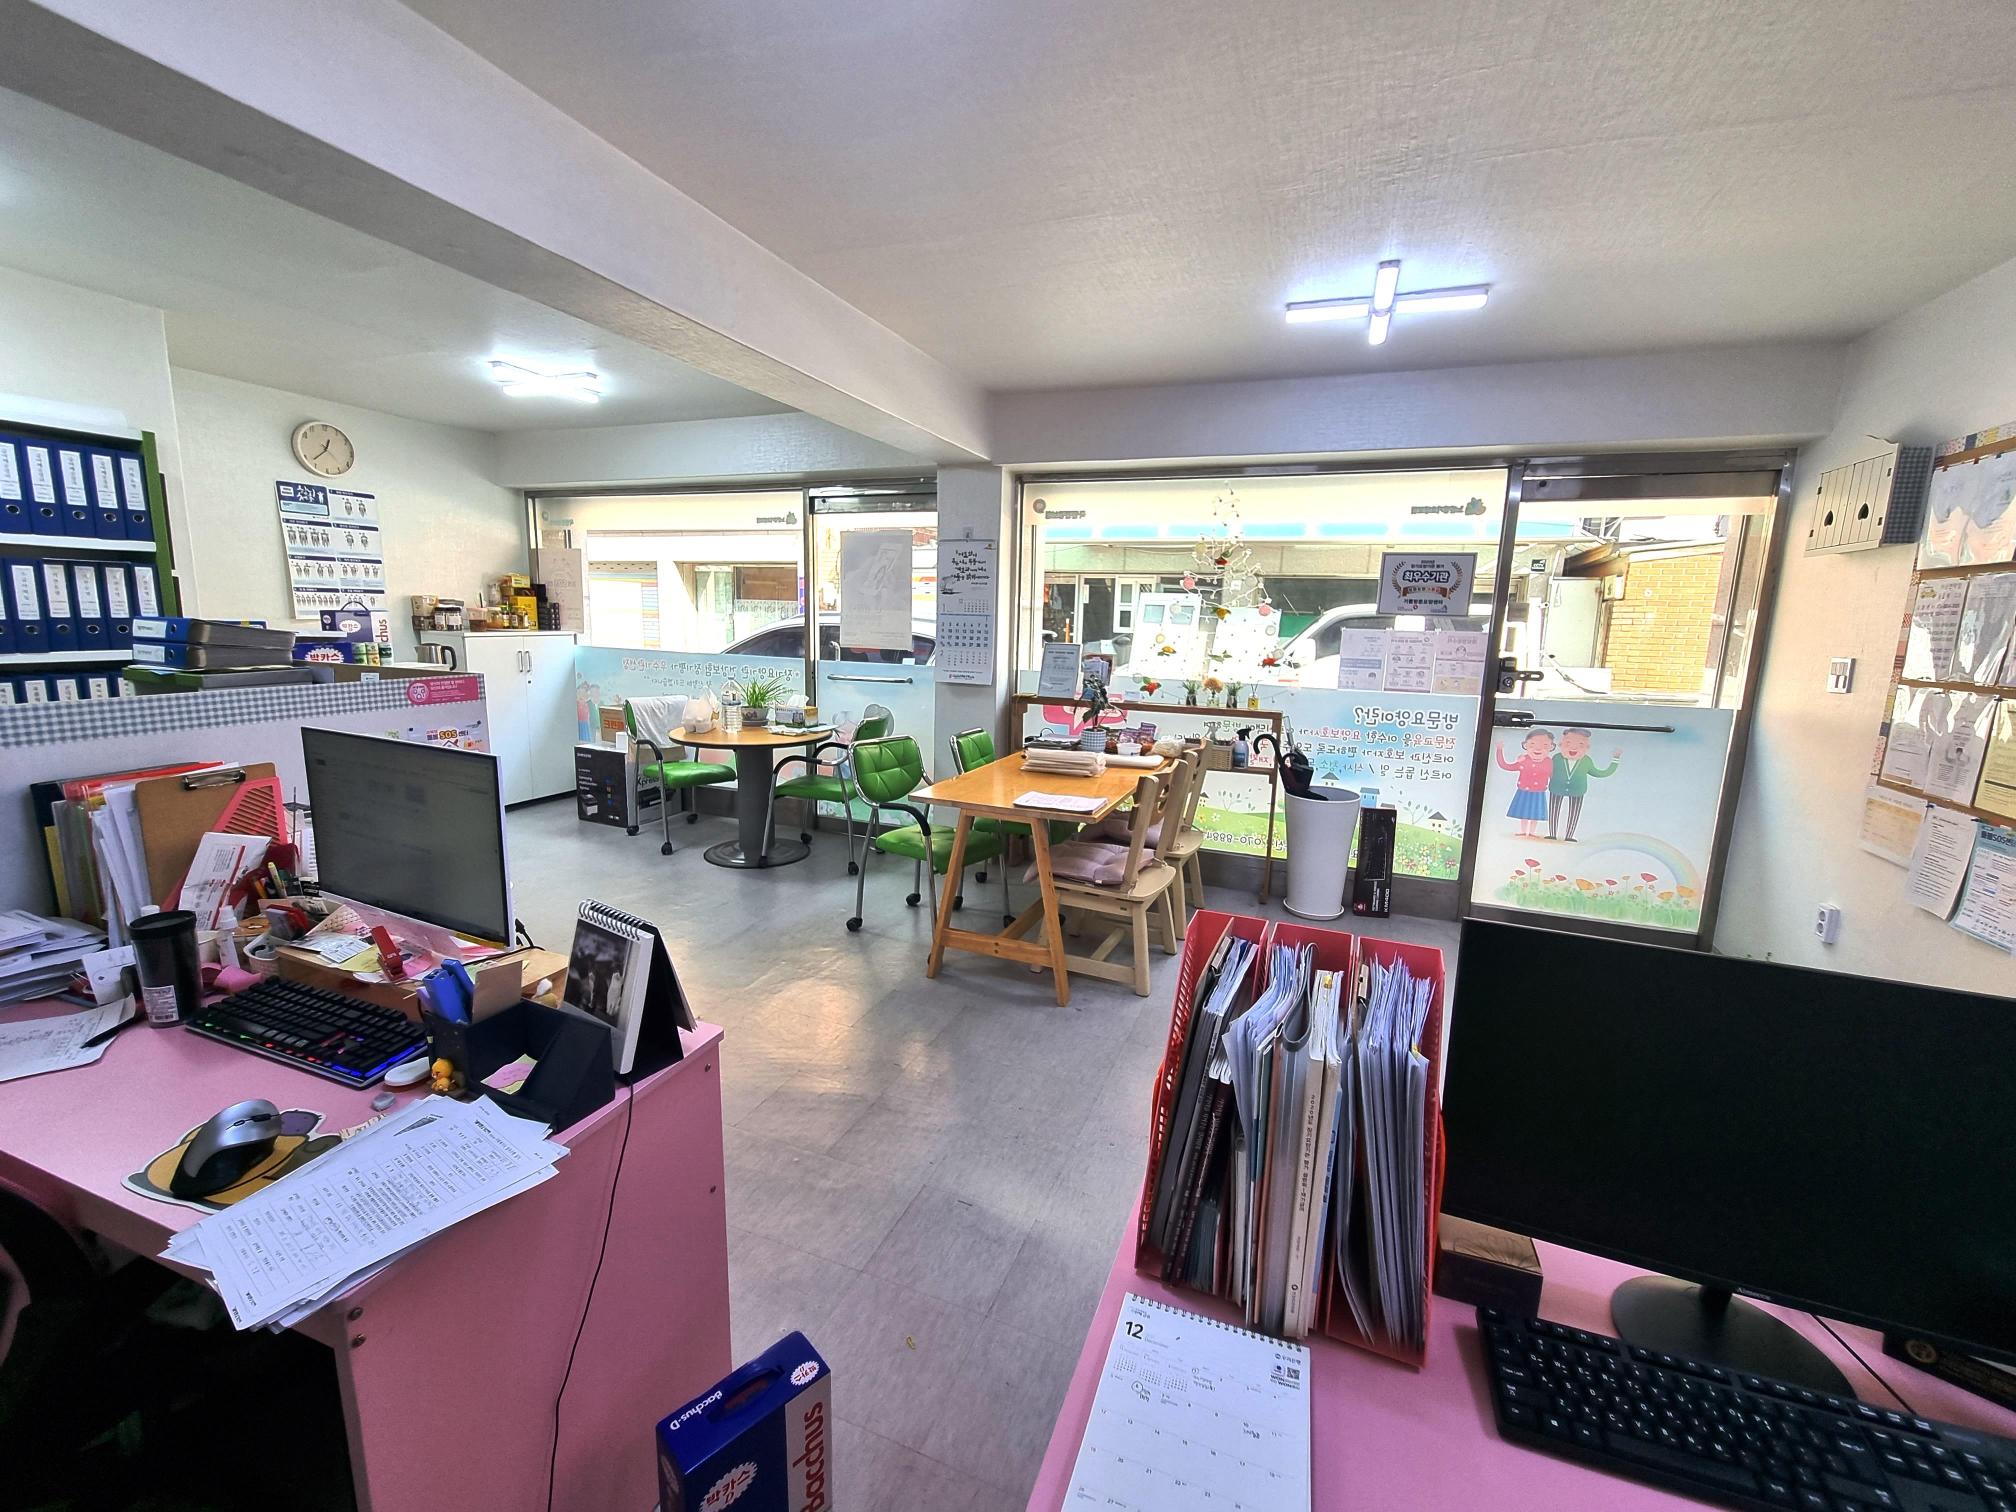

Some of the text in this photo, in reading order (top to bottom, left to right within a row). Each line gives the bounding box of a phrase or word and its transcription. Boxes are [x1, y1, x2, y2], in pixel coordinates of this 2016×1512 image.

[1403, 570, 1450, 583] 최우수기관
[439, 730, 458, 740] SOS
[1125, 1320, 1144, 1340] 12
[669, 1389, 723, 1431] Bacchus-D
[793, 1401, 825, 1512] Bacchus
